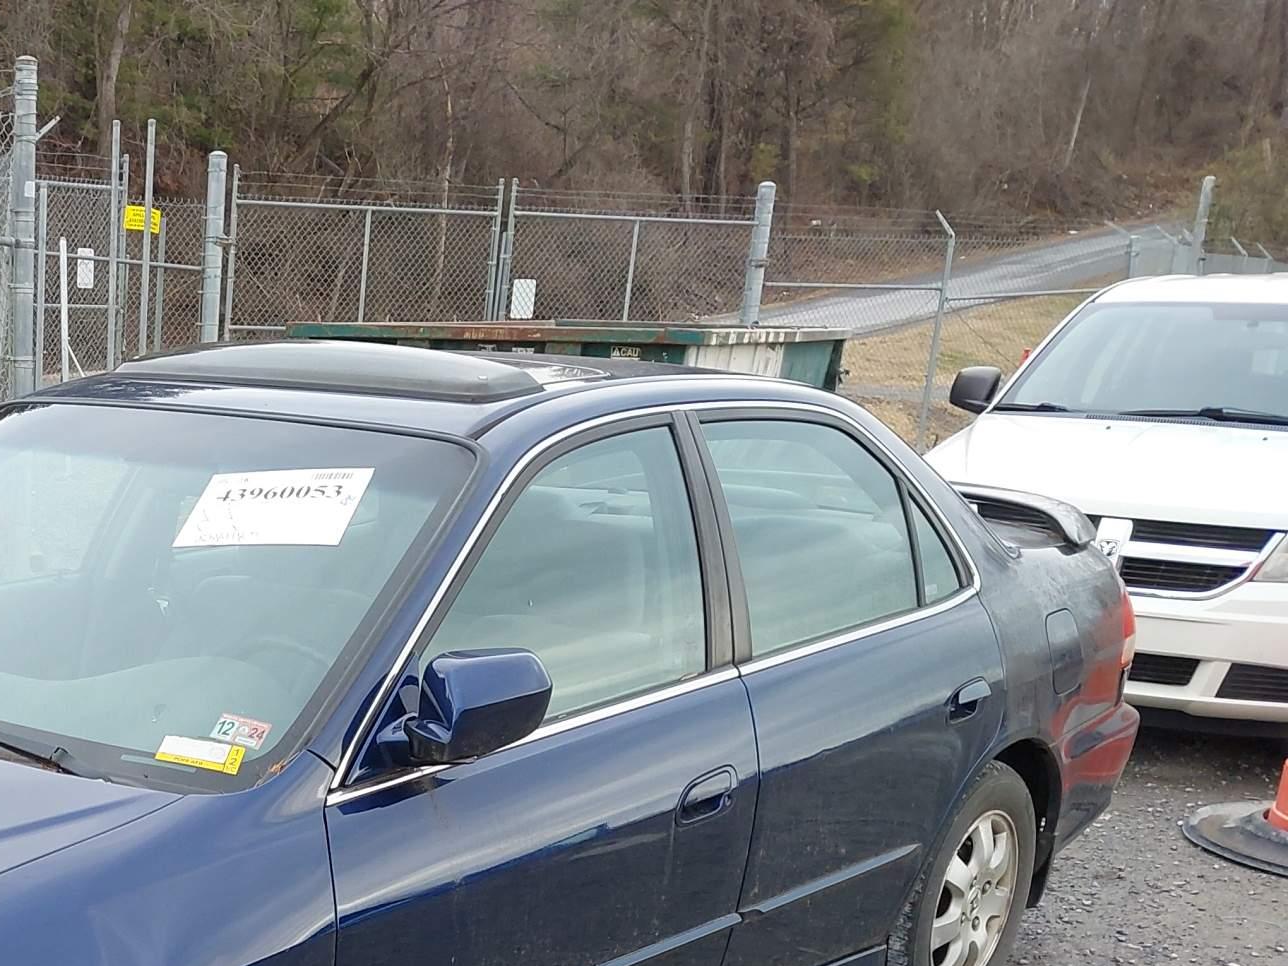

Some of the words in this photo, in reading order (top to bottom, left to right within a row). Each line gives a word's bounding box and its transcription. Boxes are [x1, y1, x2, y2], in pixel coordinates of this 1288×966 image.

[216, 485, 343, 502] 43960053
[216, 720, 235, 736] 12
[248, 727, 265, 740] 24
